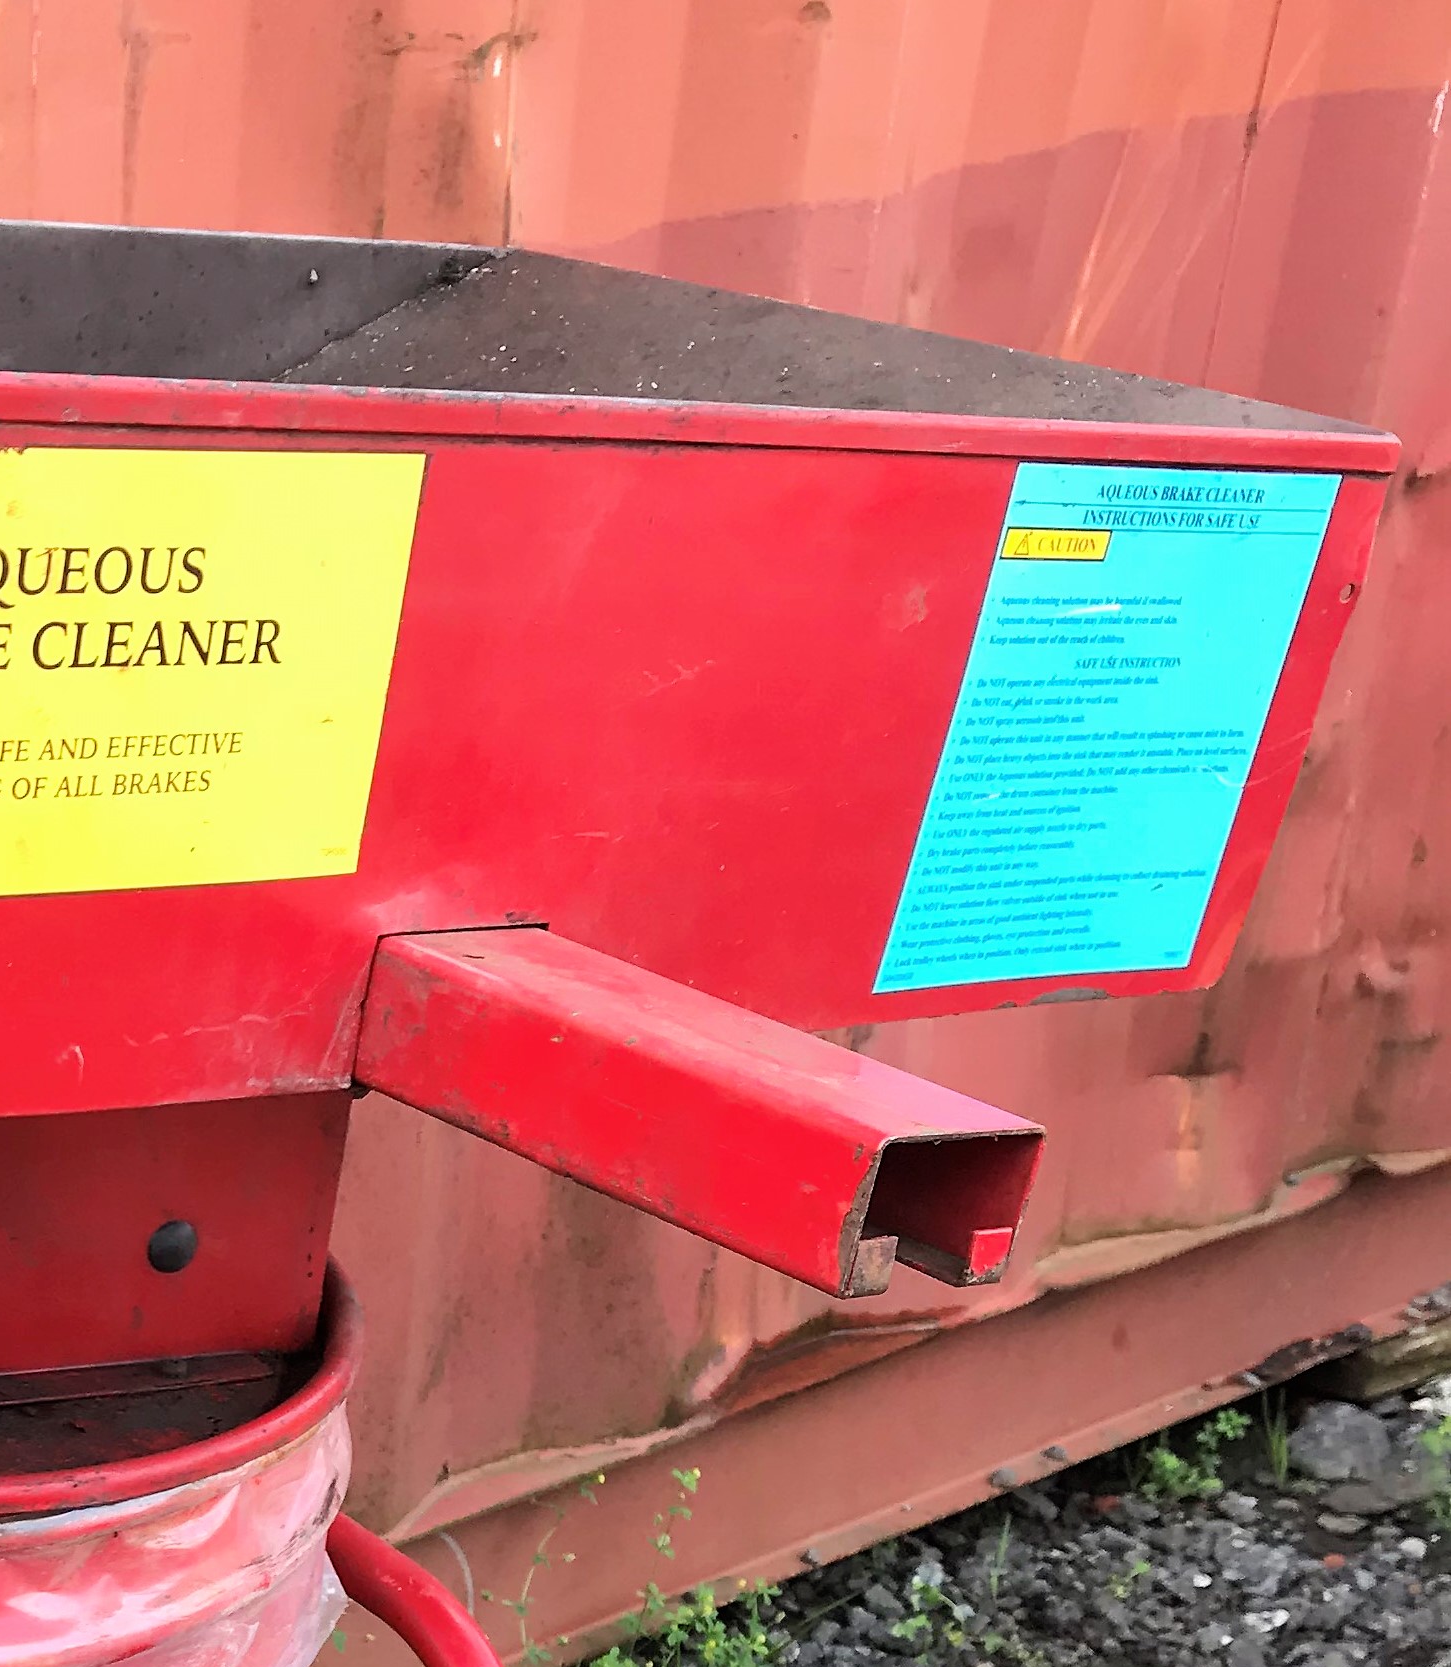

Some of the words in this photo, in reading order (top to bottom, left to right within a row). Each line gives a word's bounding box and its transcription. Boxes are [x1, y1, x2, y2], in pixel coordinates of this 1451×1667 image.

[1097, 484, 1160, 502] AQUEOUS
[1160, 486, 1205, 503] BRAKE
[1205, 487, 1266, 504] CLEANER
[1083, 509, 1177, 528] INSTRUCTIONS
[1177, 512, 1203, 528] FOR
[1204, 513, 1237, 529] SAFE
[1237, 514, 1262, 529] USE
[1037, 536, 1098, 553] CAUTION
[31, 618, 283, 670] CLEANER
[1074, 658, 1100, 669] SAFE
[1119, 657, 1181, 669] INSTRUCTION
[38, 736, 99, 762] AND
[105, 731, 244, 759] EFFECTIVE
[10, 776, 48, 800] OF
[53, 774, 106, 798] ALL
[112, 769, 212, 795] BRAKES
